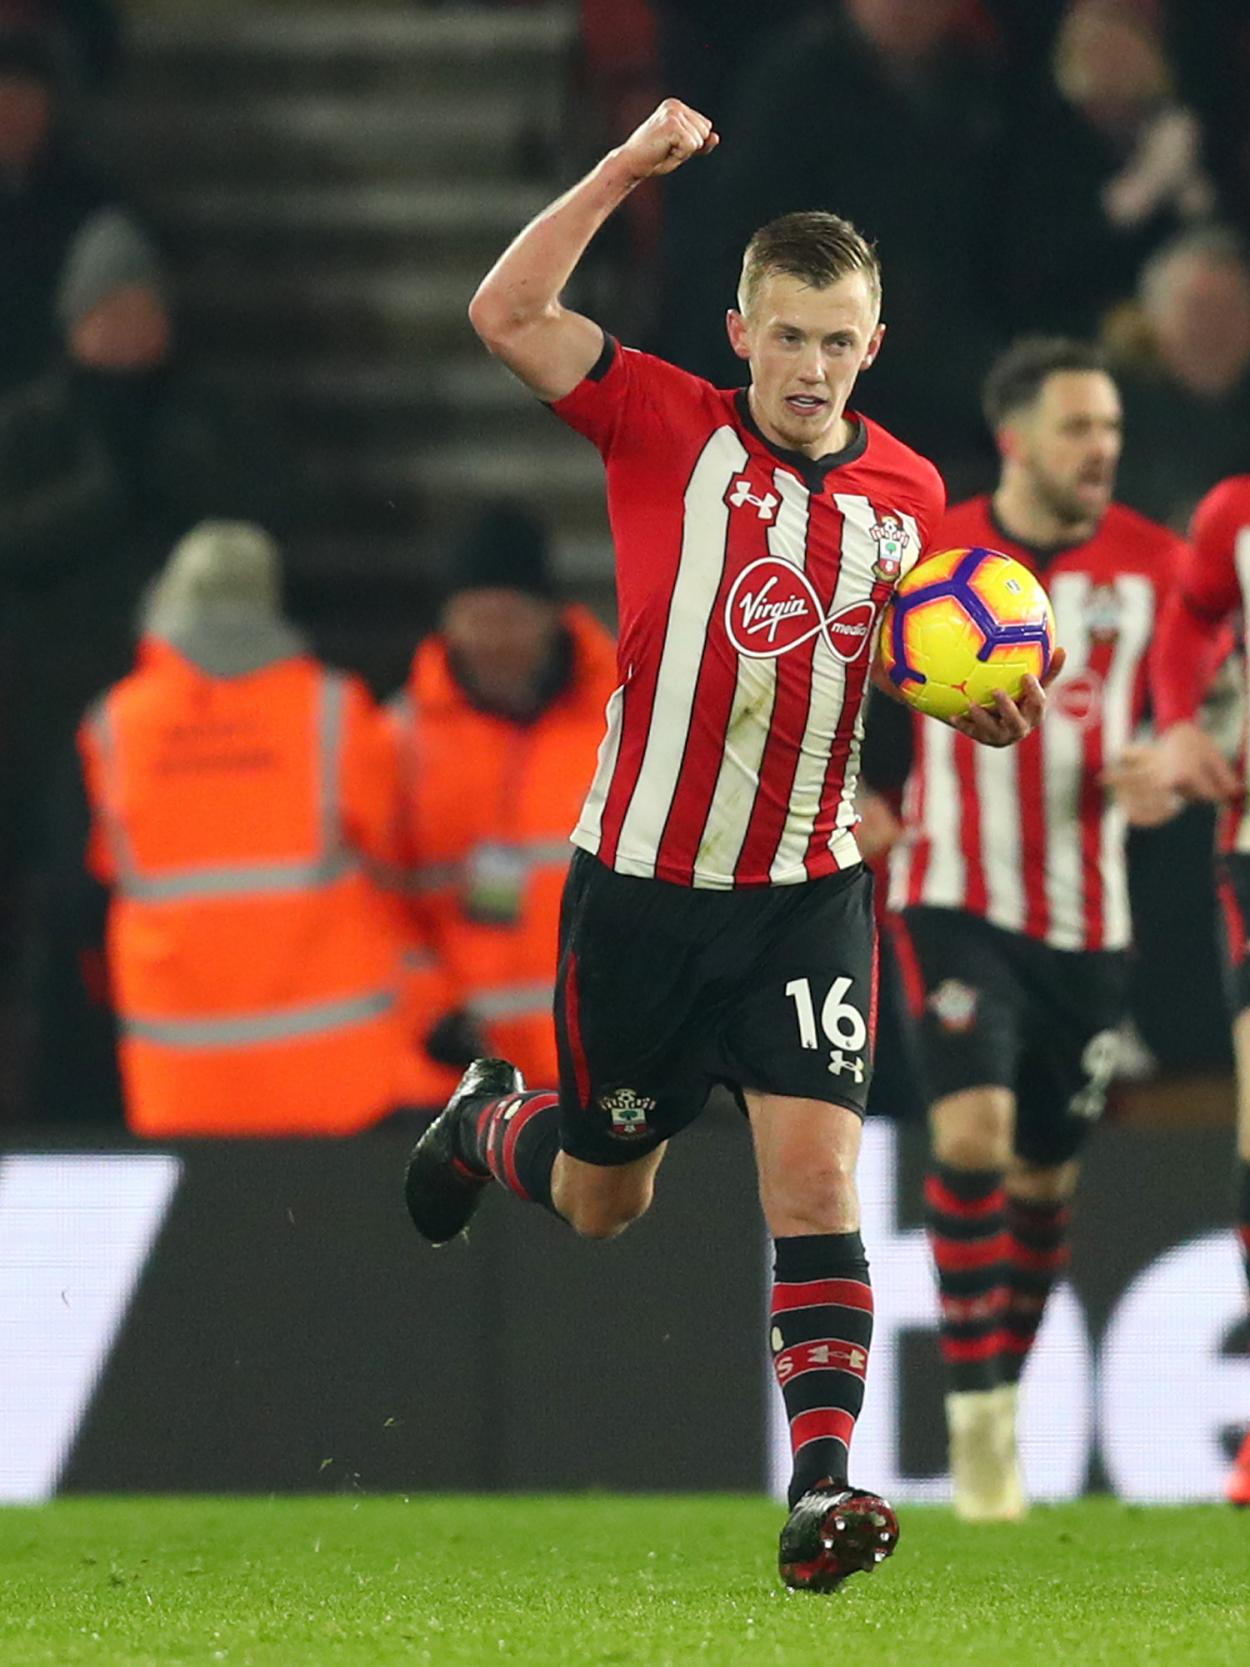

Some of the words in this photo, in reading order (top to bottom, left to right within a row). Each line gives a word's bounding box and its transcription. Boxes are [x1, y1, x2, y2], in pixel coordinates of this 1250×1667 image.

[739, 575, 809, 643] Virgin
[831, 621, 868, 636] media
[786, 976, 867, 1051] 16
